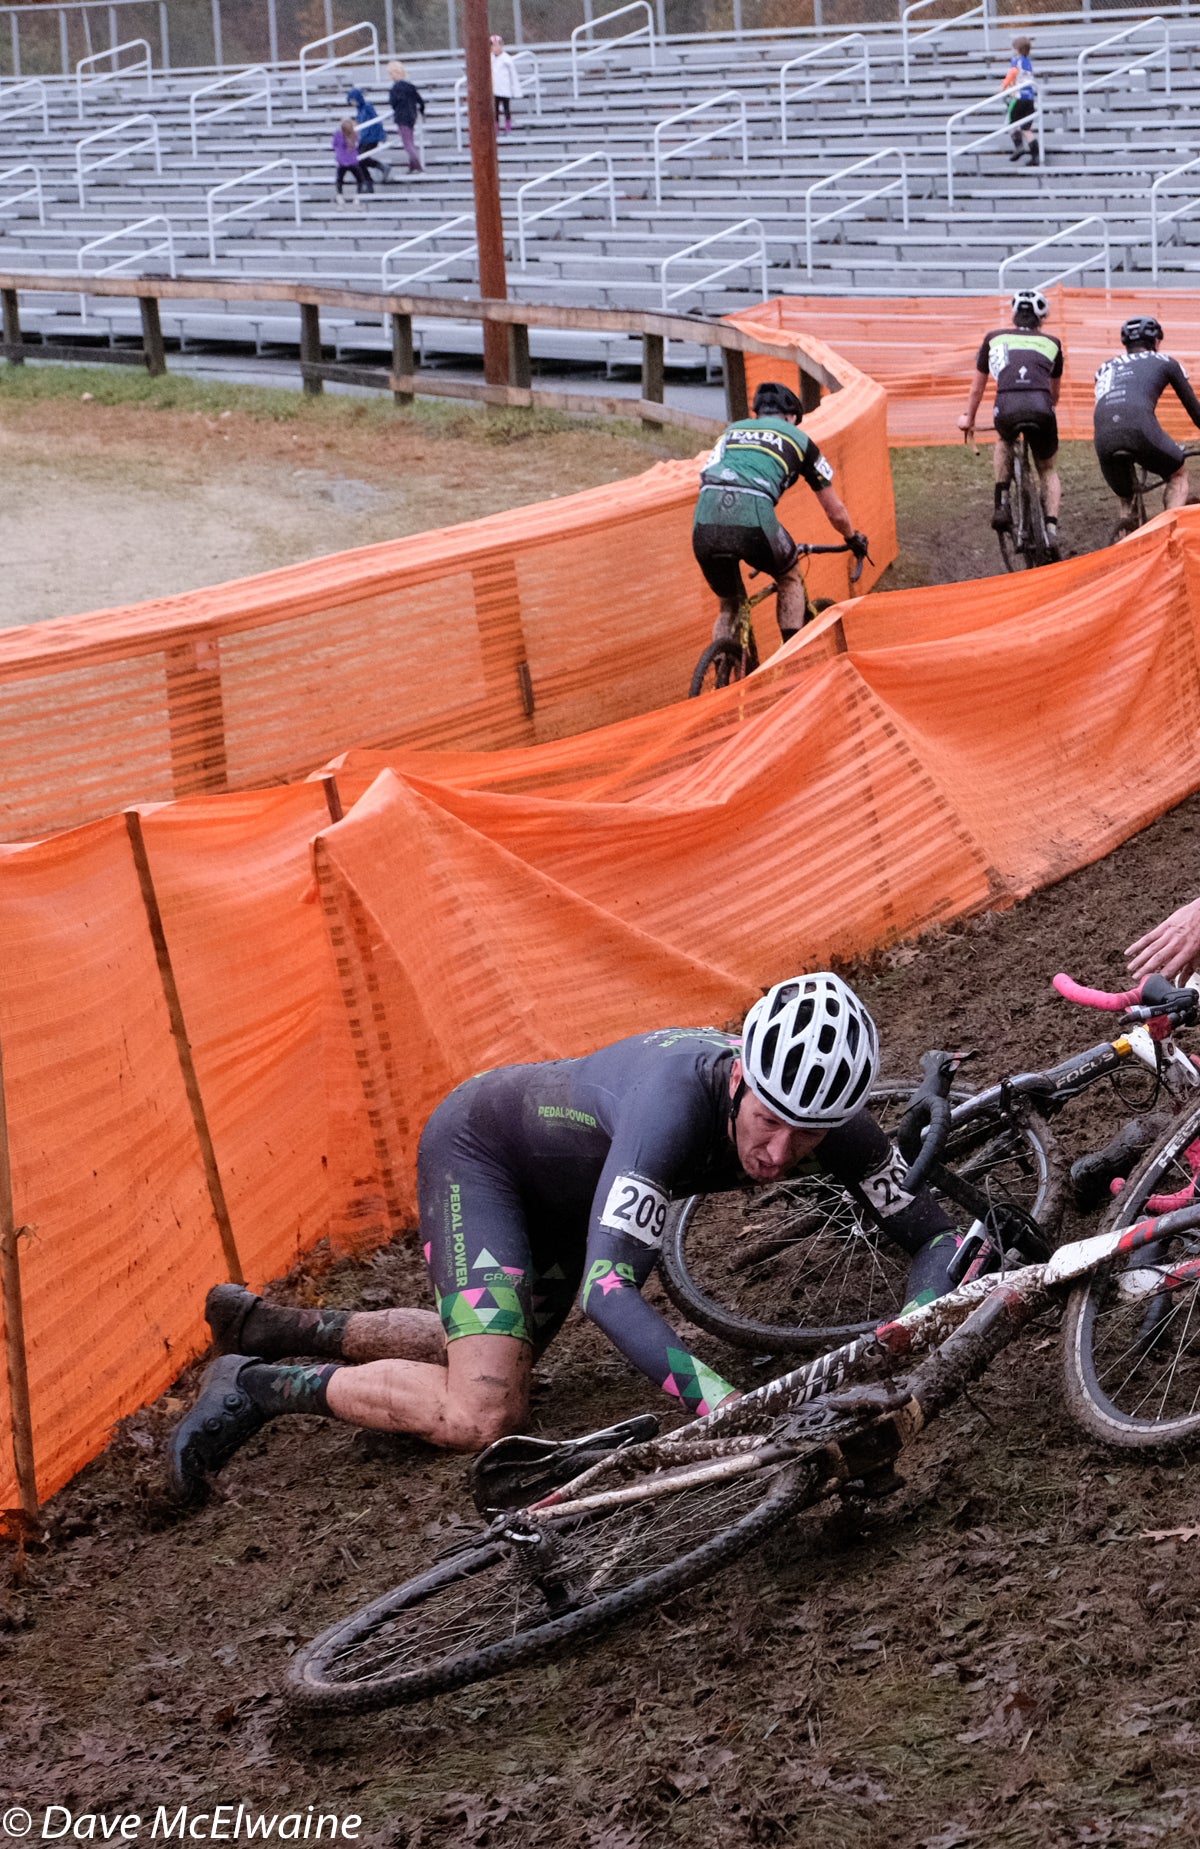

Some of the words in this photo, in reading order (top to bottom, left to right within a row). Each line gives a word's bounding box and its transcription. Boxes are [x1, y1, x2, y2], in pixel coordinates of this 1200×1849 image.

[731, 430, 784, 453] EMBA
[1055, 1051, 1116, 1090] FOCUS
[537, 1105, 565, 1119] PEDAL
[565, 1108, 597, 1129] POWER
[450, 1184, 464, 1231] PEDAL
[612, 1185, 667, 1238] 209
[453, 1232, 469, 1288] POWER
[483, 1272, 525, 1283] CRAFT
